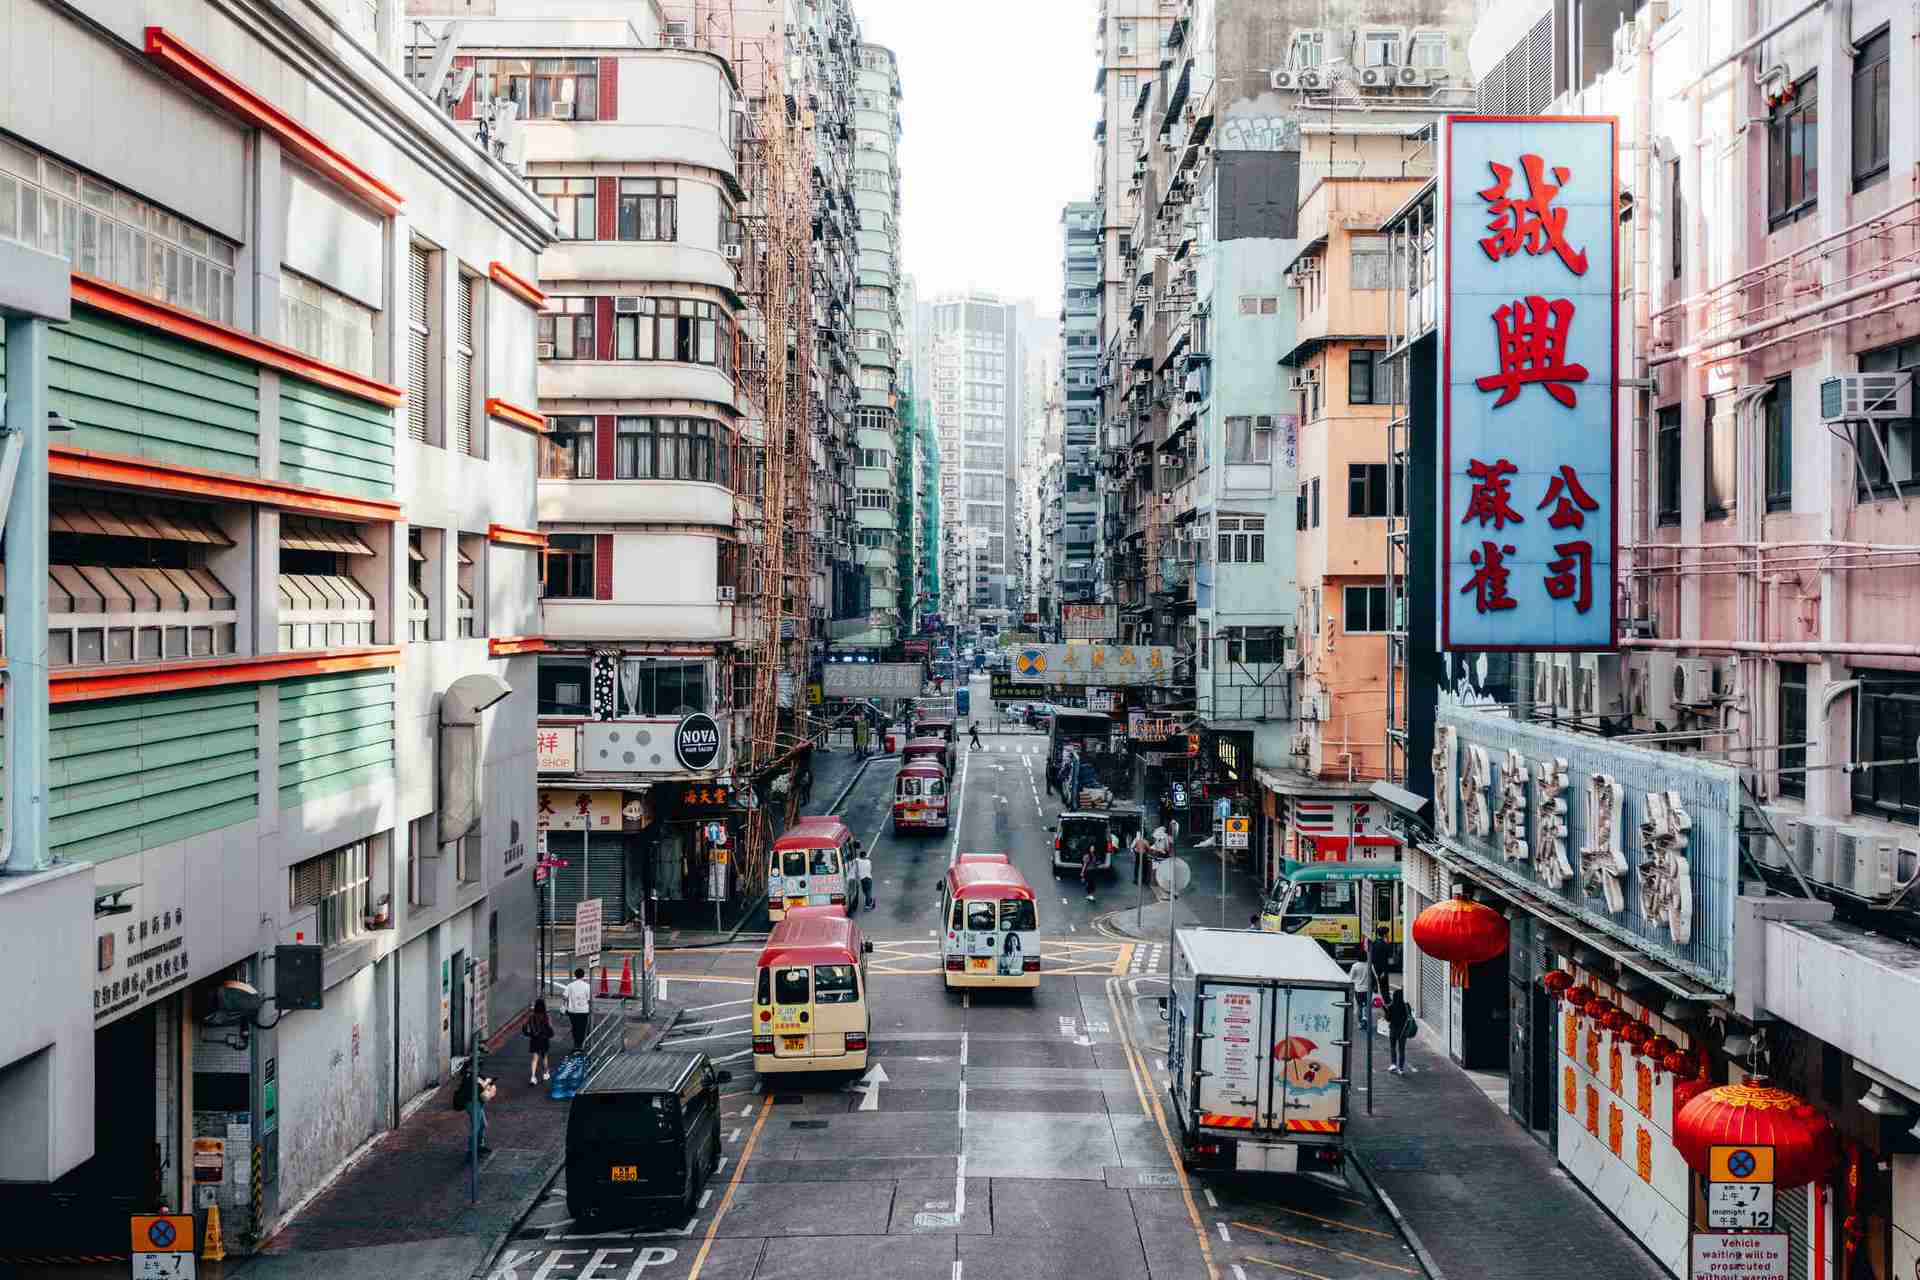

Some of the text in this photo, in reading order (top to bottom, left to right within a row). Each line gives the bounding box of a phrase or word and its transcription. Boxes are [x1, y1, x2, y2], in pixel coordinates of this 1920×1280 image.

[1476, 153, 1590, 411] 誠興
[1536, 464, 1599, 614] 公司
[538, 732, 559, 754] 祥
[682, 729, 717, 744] NOVA
[543, 759, 570, 768] SHOP
[1749, 1186, 1760, 1201] 7
[1712, 1208, 1746, 1216] midnight
[1750, 1212, 1769, 1226] 12
[1721, 1239, 1761, 1248] Vehicle
[171, 1255, 182, 1269] 7
[1702, 1250, 1778, 1261] waiting will be
[1710, 1262, 1771, 1272] prosecuted
